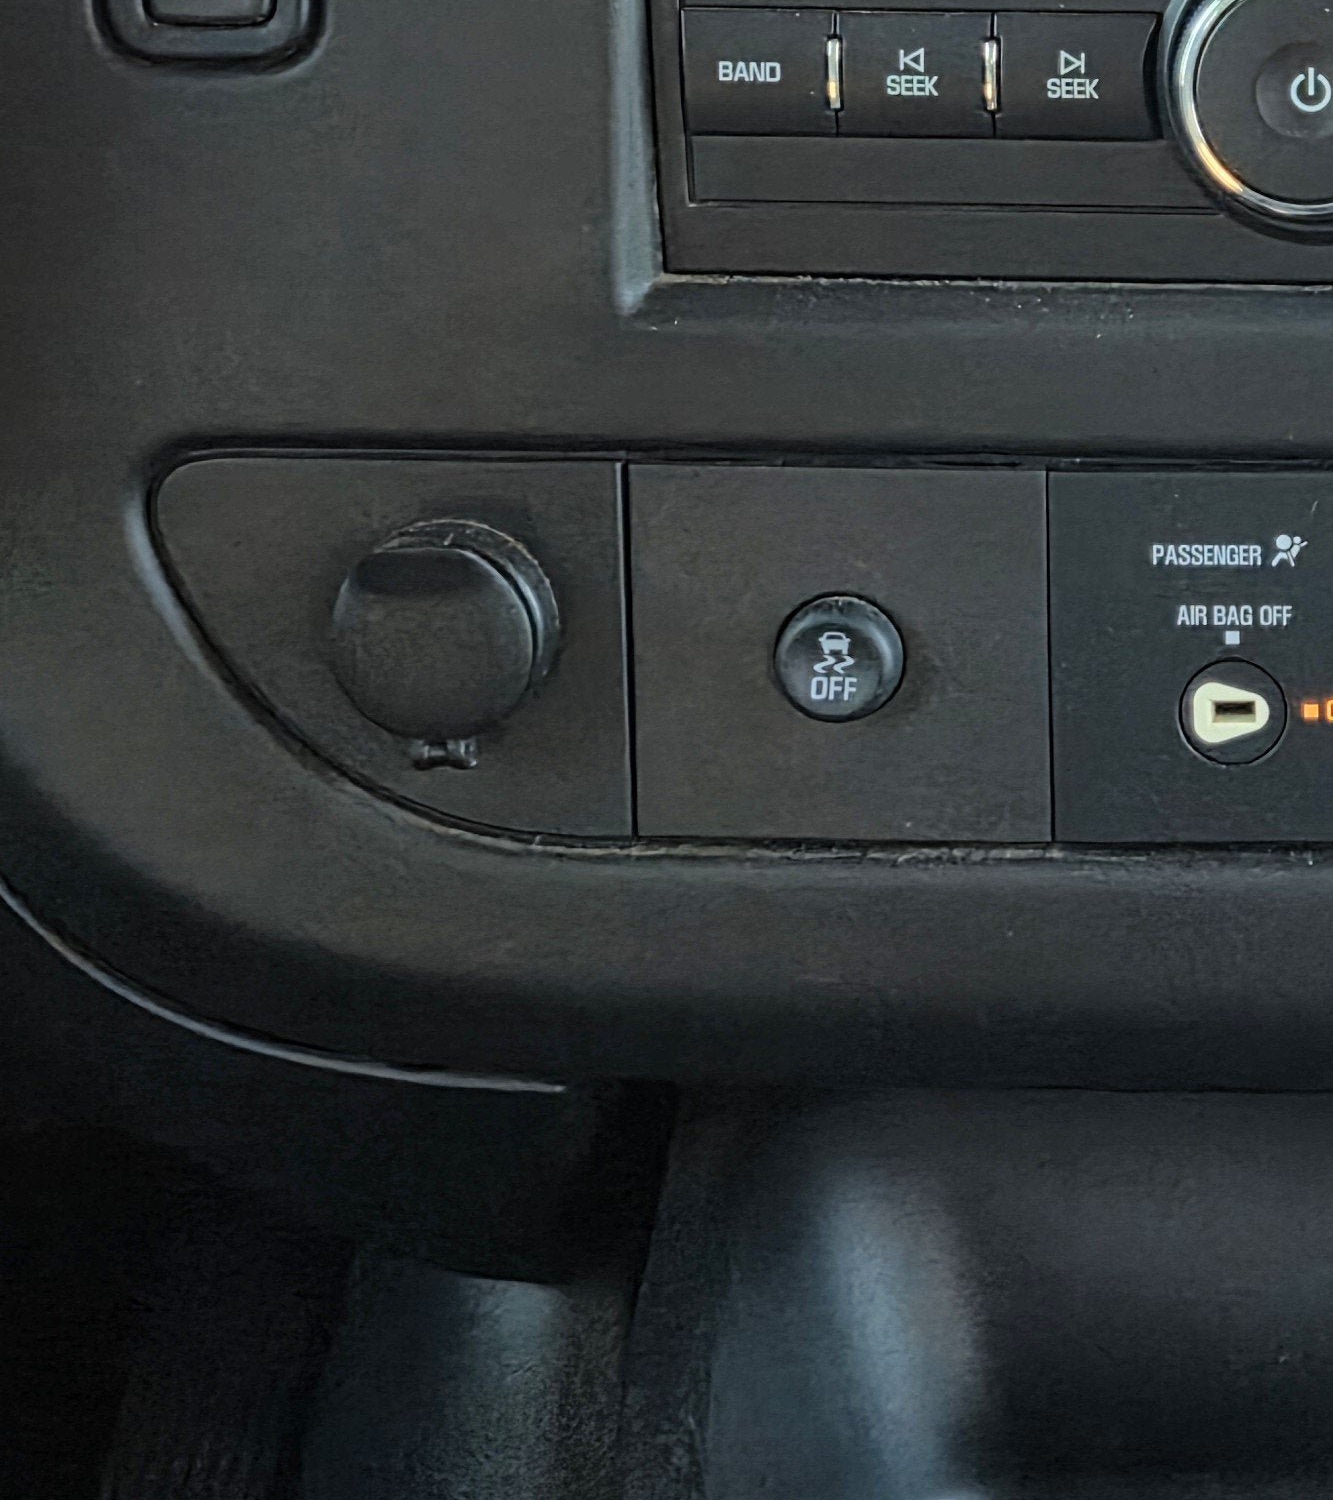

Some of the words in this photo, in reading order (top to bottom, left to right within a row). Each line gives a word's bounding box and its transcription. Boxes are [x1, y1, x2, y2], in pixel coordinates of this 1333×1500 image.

[718, 60, 781, 83] BAND
[886, 74, 939, 96] SEEK
[1046, 77, 1099, 99] SEEK
[1152, 544, 1262, 566] PASSENGER
[1176, 604, 1208, 626] AIR
[1213, 604, 1253, 627] BAG
[1259, 604, 1293, 626] OFF
[810, 676, 858, 701] OFF
